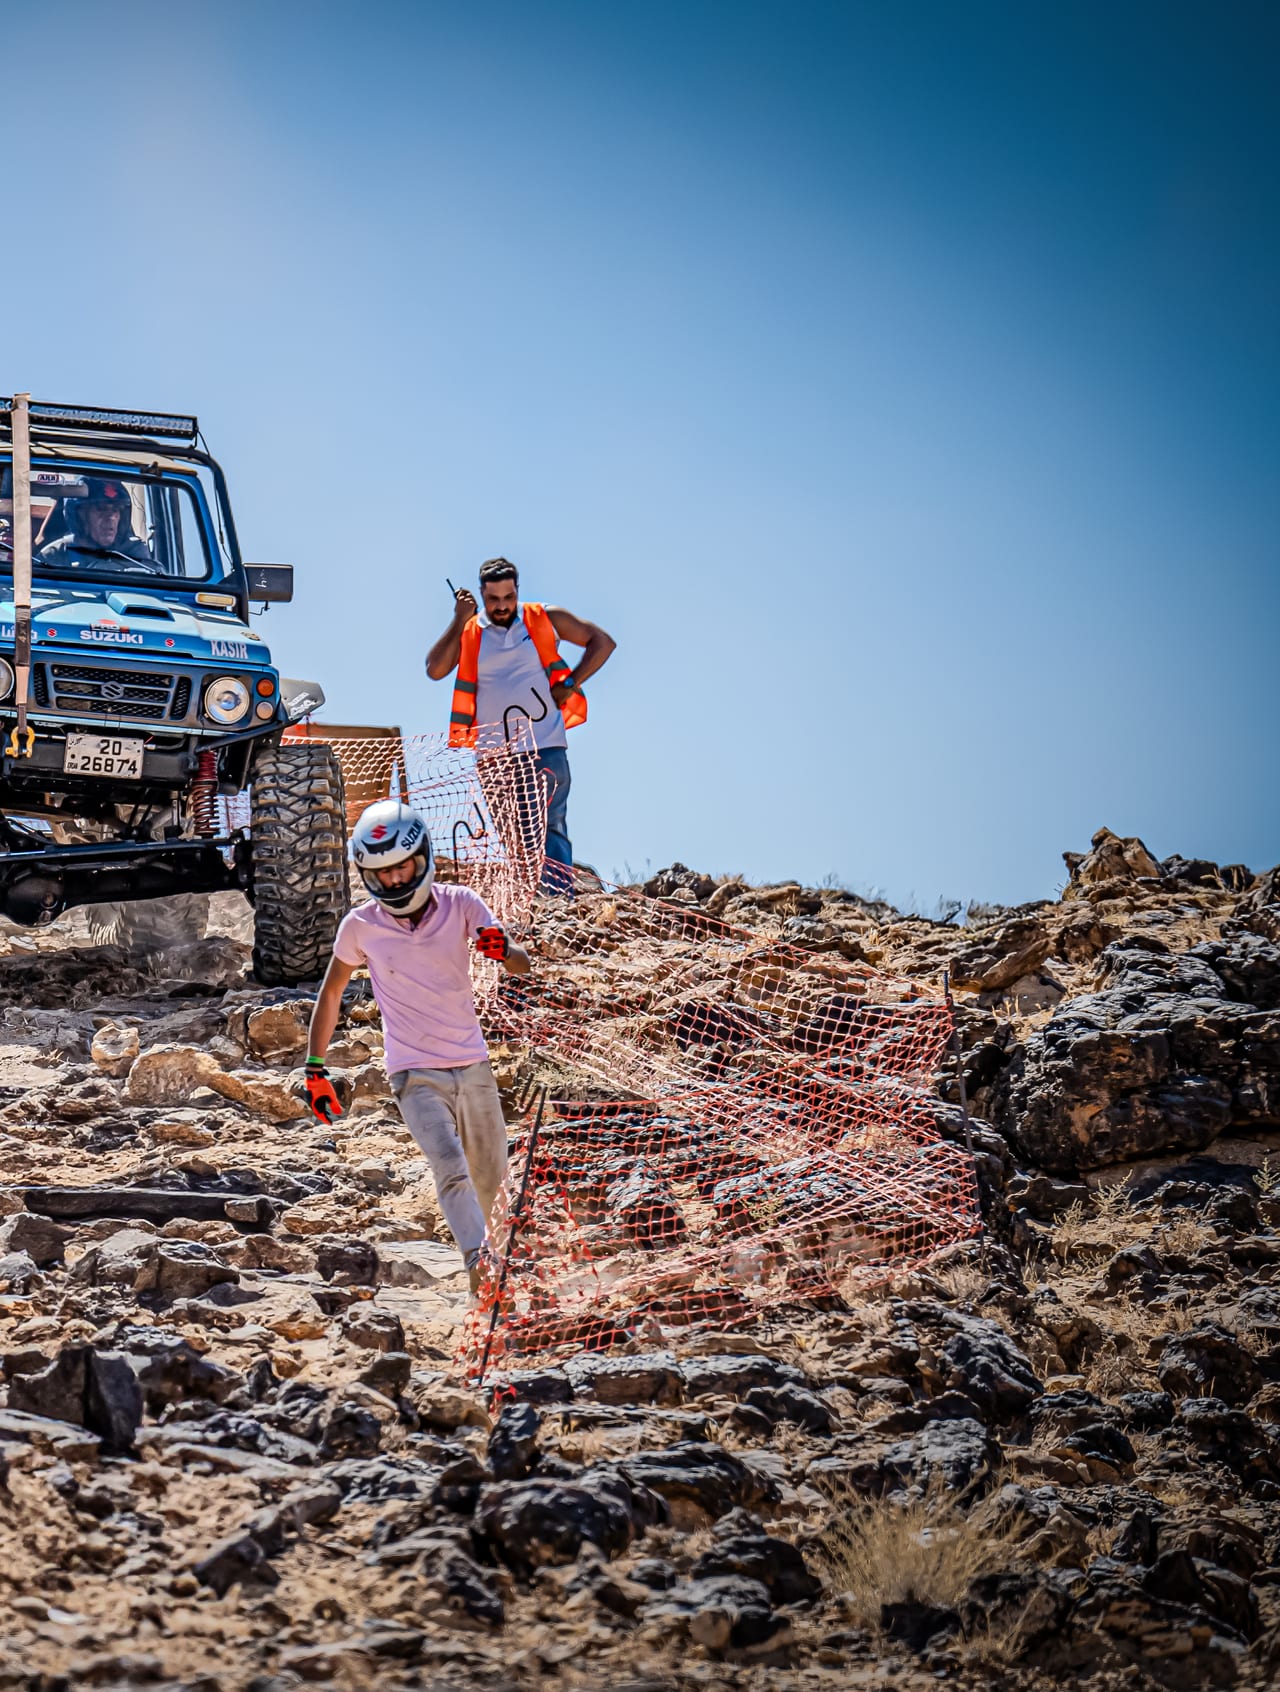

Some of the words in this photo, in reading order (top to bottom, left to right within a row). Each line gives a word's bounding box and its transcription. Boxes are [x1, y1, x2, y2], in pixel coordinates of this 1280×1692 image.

[80, 630, 143, 644] SUZUKI
[210, 640, 249, 659] KASIR
[100, 739, 122, 756] 20
[80, 755, 138, 775] 26874
